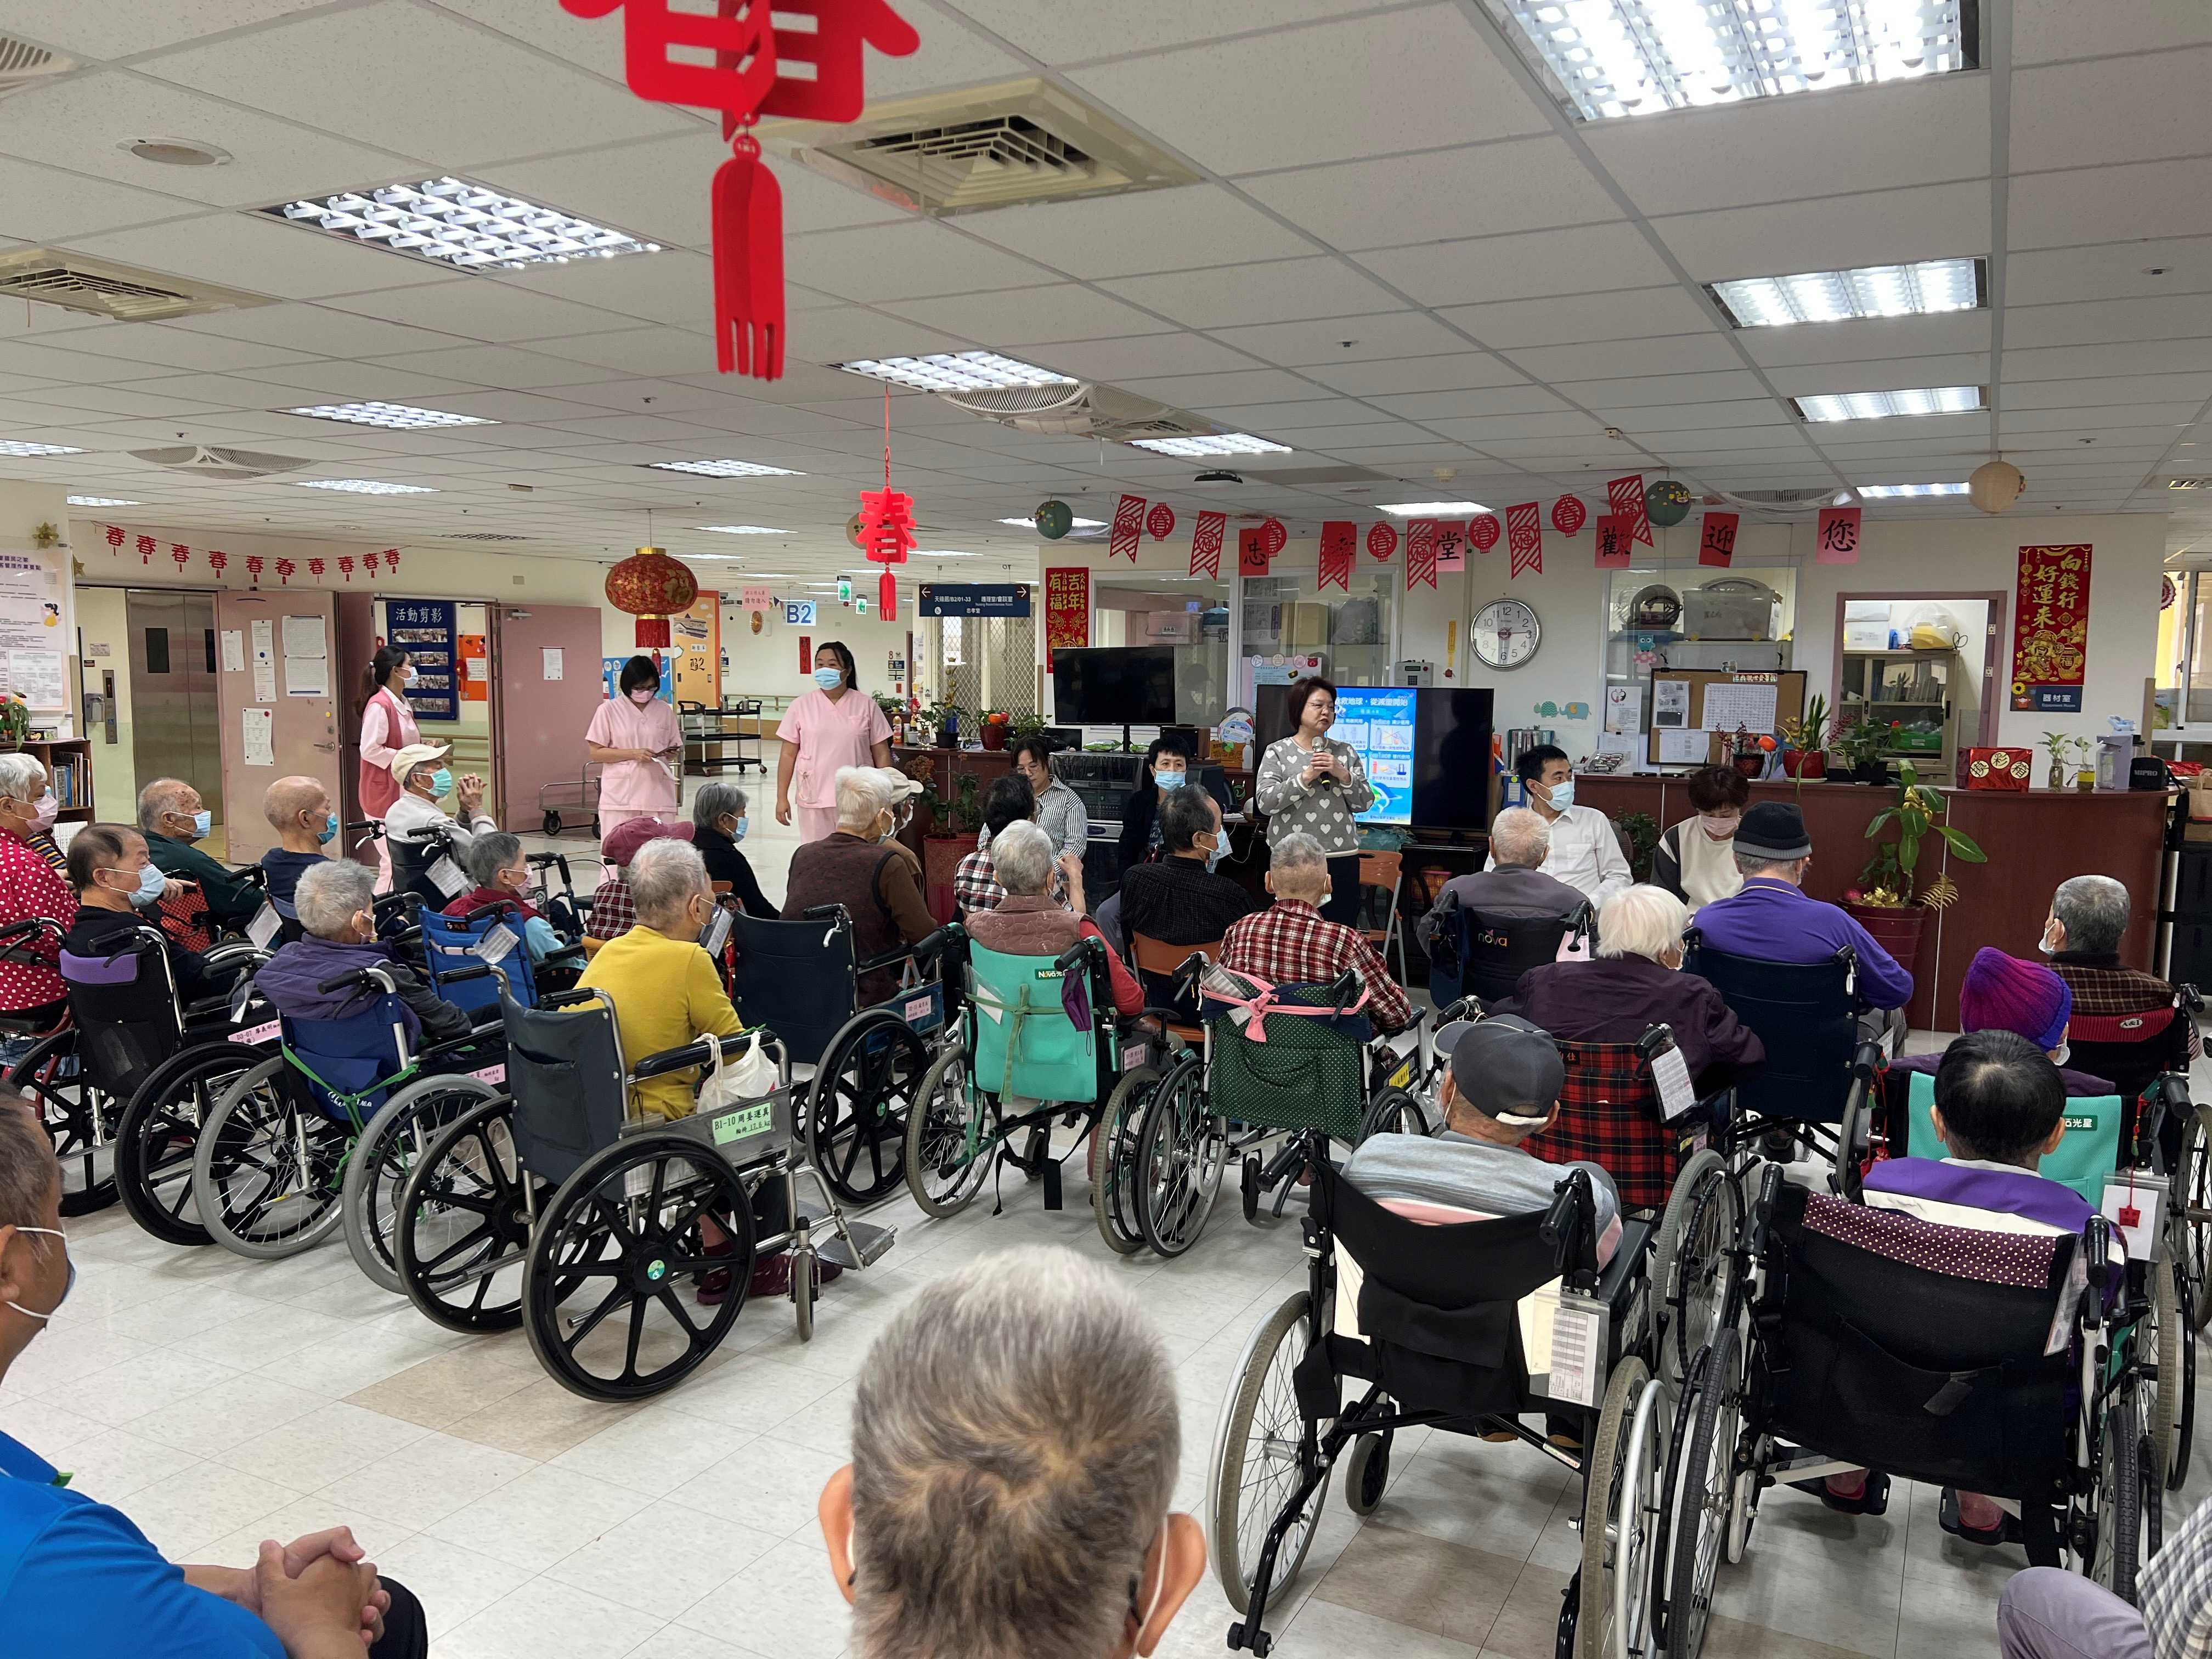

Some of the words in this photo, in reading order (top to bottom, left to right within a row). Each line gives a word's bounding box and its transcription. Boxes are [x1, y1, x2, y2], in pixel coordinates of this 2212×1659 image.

[106, 525, 125, 546] 春
[1703, 524, 1734, 556] 迎
[1822, 519, 1856, 552] 您
[136, 535, 156, 555] 春
[171, 543, 189, 562] 春
[1244, 538, 1266, 566] 忠
[1436, 531, 1463, 561] 堂
[208, 551, 227, 569] 春
[246, 556, 263, 573] 春
[337, 556, 354, 573] 春
[362, 553, 379, 569] 春
[383, 549, 400, 566] 春
[275, 557, 296, 576] 春
[308, 558, 325, 574] 春
[2057, 554, 2082, 609] 向錢行
[1049, 573, 1062, 611] 有福
[1068, 574, 1080, 611] 吉年
[396, 607, 442, 623] 活動剪影
[787, 605, 811, 623] B2
[1492, 610, 1499, 618] 11
[1503, 607, 1511, 615] 12
[1483, 618, 1493, 627] 10
[1522, 619, 1528, 627] 2
[1525, 630, 1532, 639] 3
[1483, 640, 1488, 648] 8
[889, 651, 893, 659] 8
[1501, 652, 1506, 660] 6
[1511, 649, 1517, 657] 5
[2061, 657, 2072, 667] 福
[2042, 694, 2072, 702] 器材室
[1478, 932, 1507, 947] nova
[714, 1116, 736, 1130] B1-10
